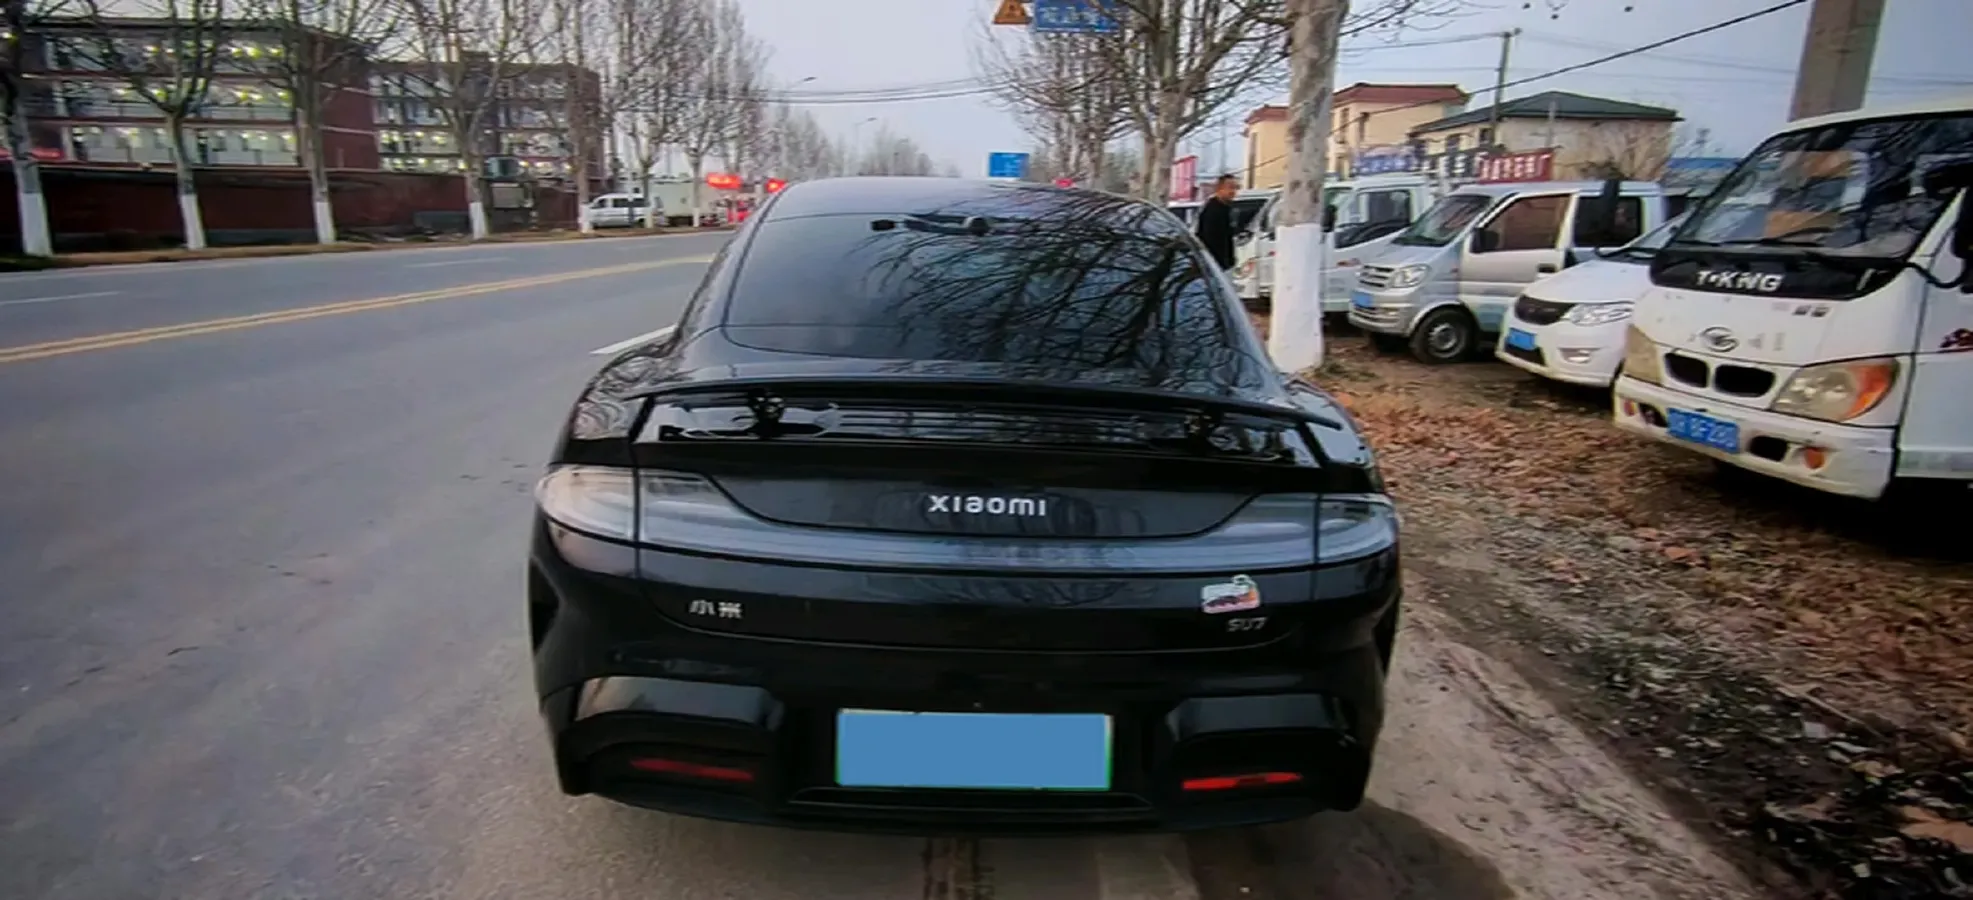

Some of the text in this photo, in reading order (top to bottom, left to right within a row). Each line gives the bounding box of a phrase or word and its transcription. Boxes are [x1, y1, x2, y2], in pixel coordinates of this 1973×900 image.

[928, 494, 1046, 516] xiaomi
[690, 599, 742, 618] 小米
[1227, 616, 1267, 632] SU7
